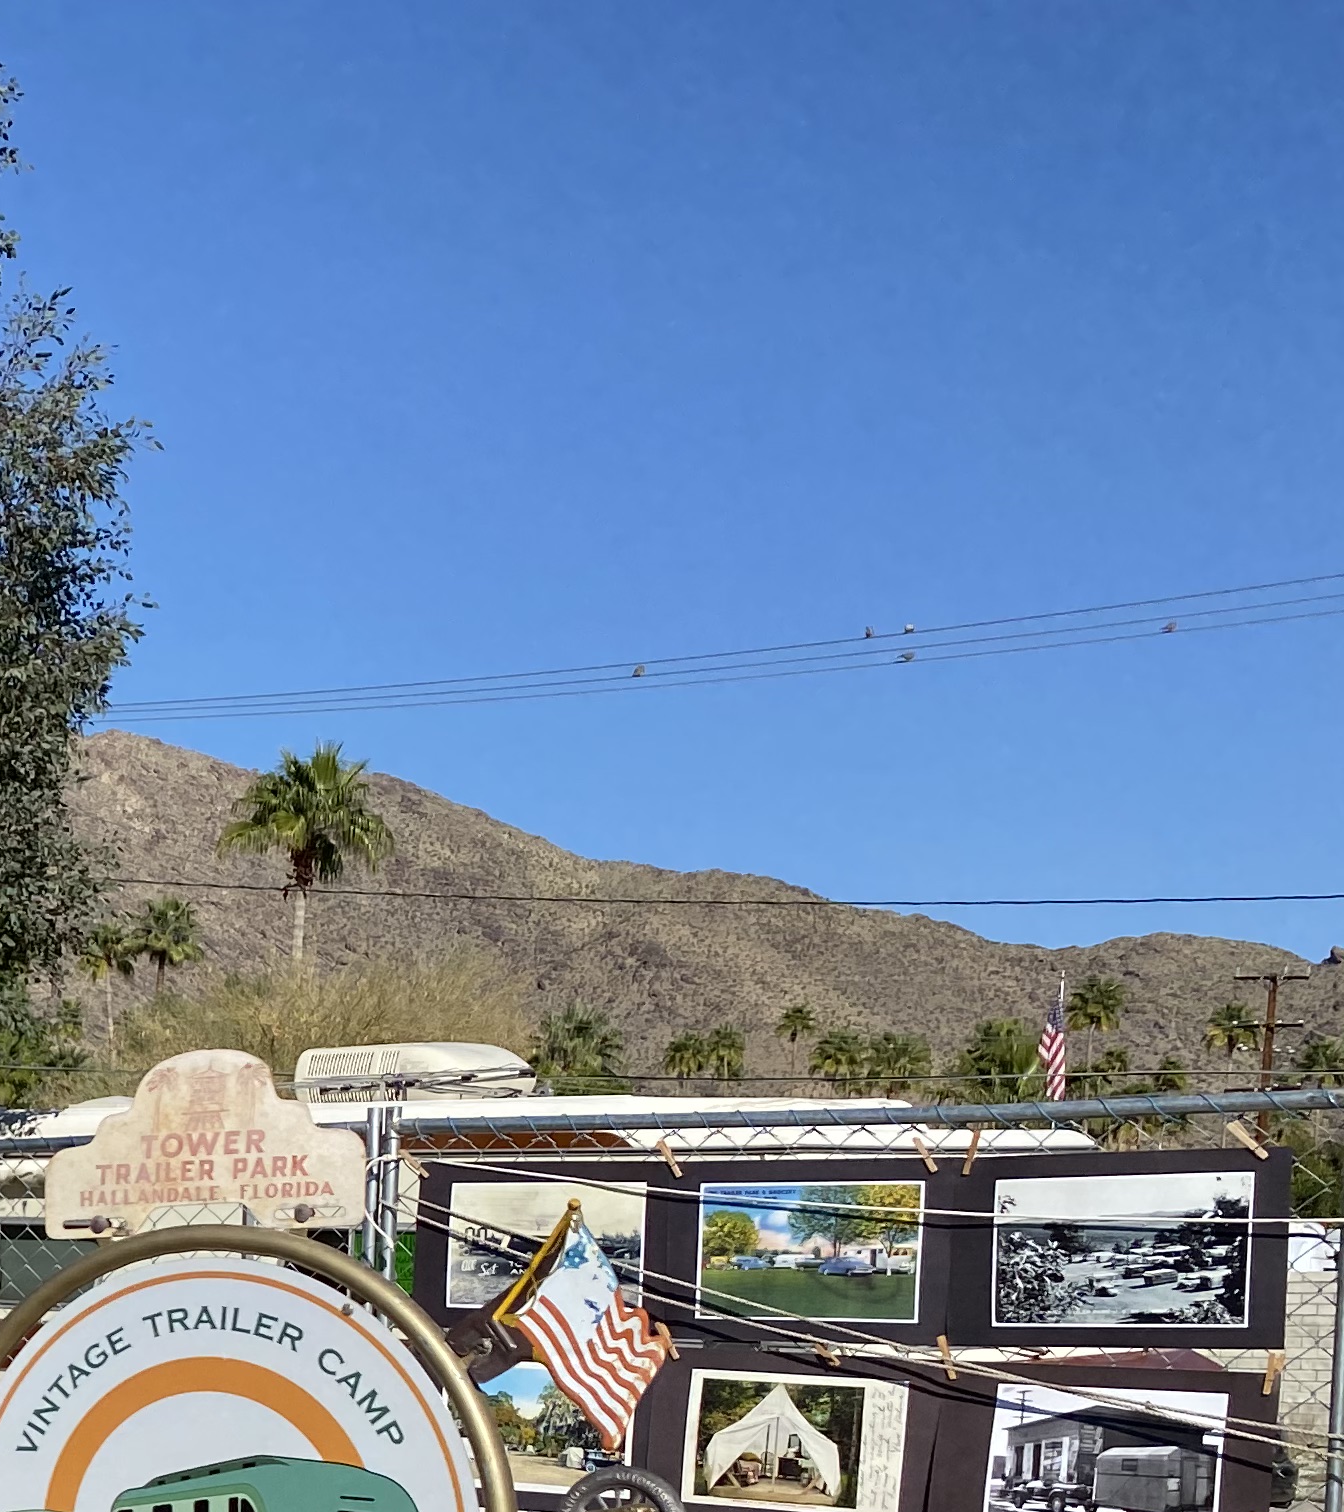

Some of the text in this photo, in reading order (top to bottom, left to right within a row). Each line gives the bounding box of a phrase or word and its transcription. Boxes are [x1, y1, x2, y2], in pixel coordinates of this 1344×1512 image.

[140, 1129, 267, 1159] TOWER
[95, 1154, 310, 1186] TRAILER PARK
[240, 1180, 335, 1199] FLORIDA
[16, 1305, 405, 1453] VINTAGE TRAILER CAMP
